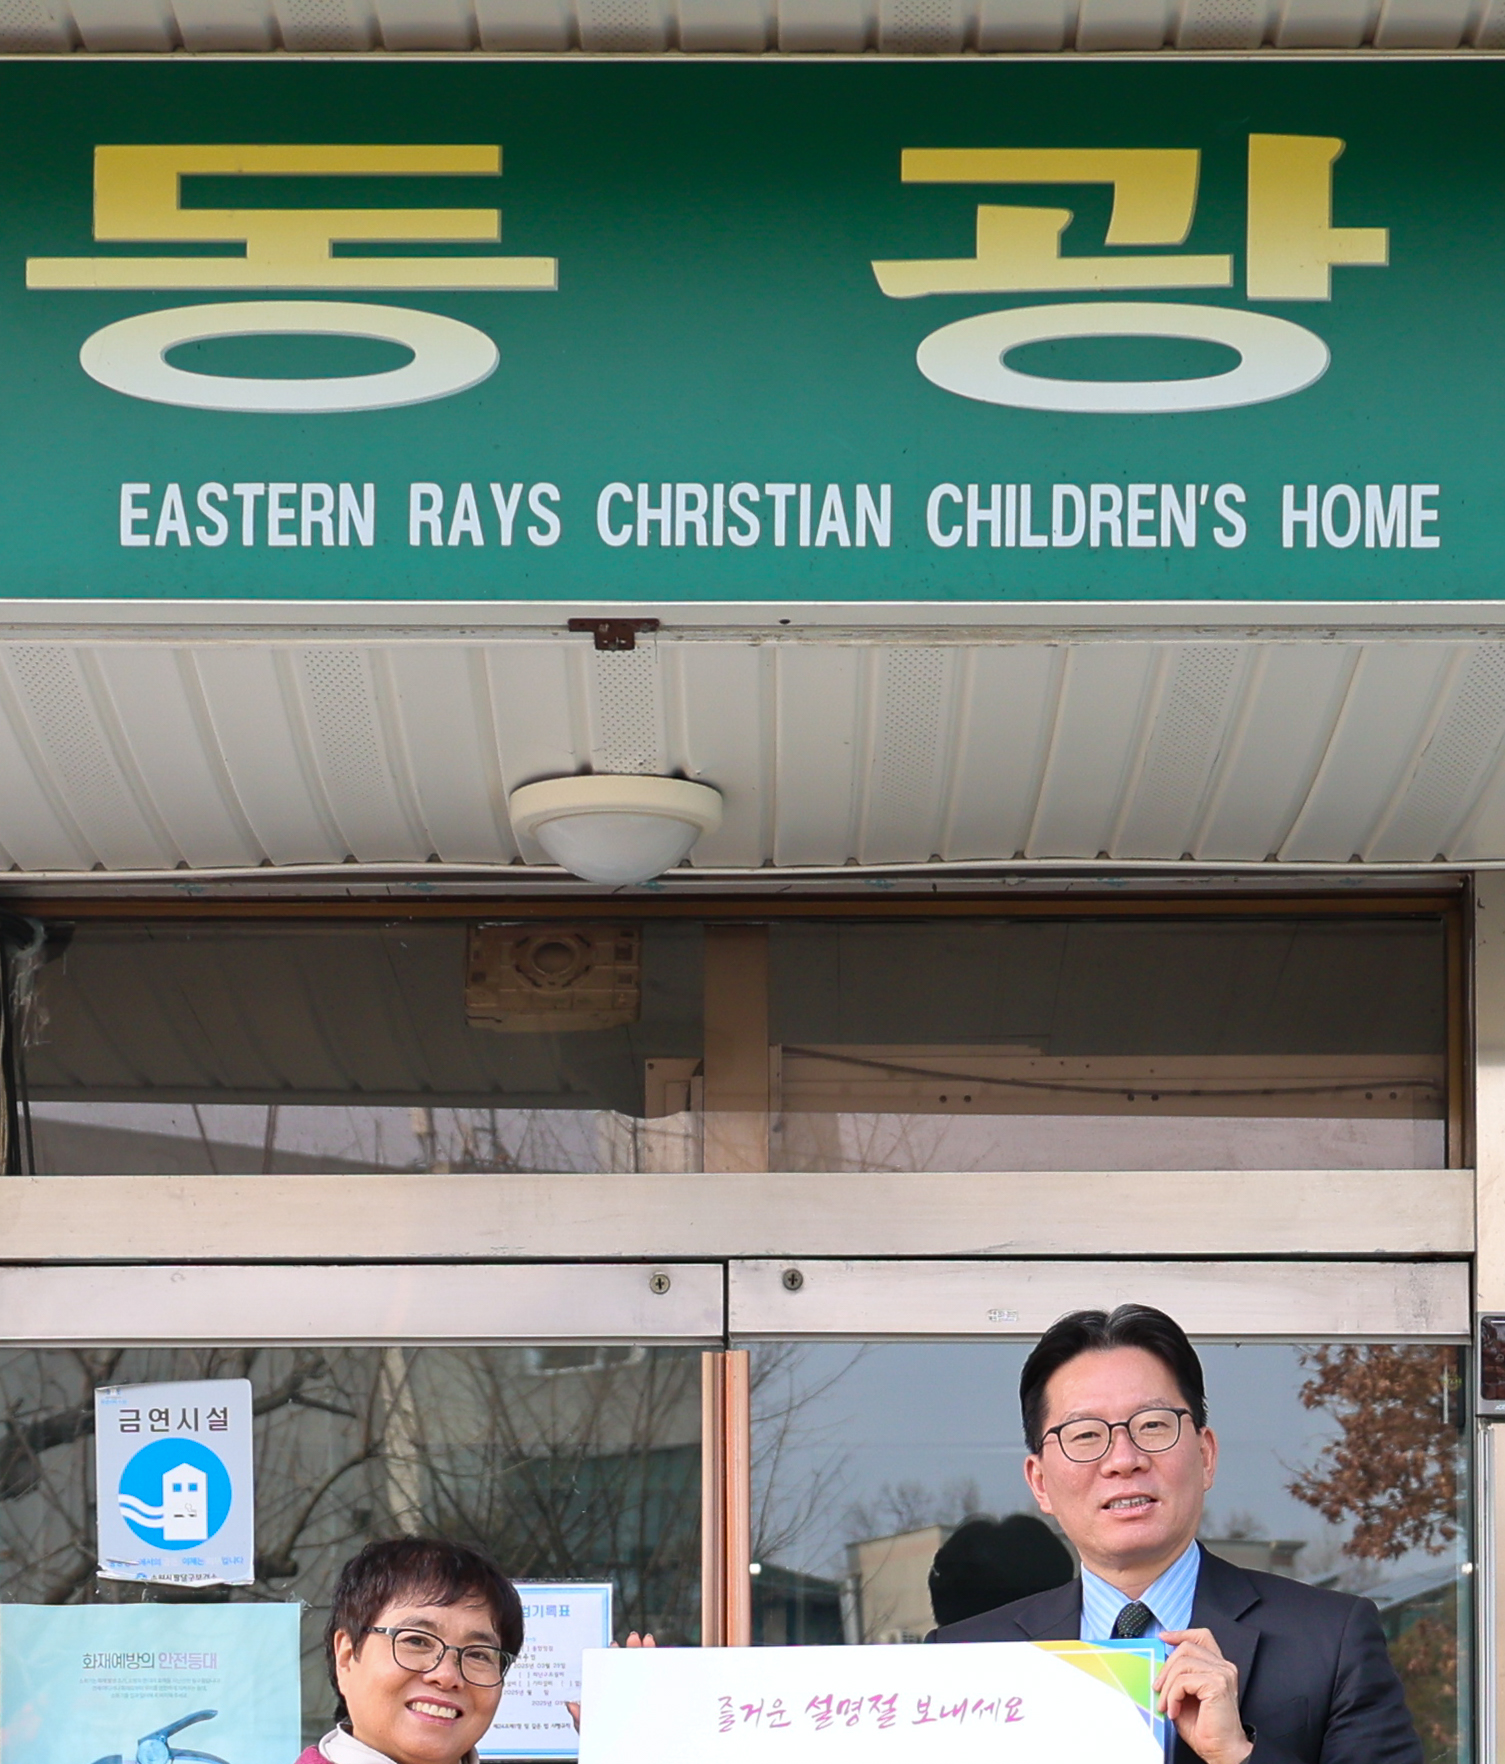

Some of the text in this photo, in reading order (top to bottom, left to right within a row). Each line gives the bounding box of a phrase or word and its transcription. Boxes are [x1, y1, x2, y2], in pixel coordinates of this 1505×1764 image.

[120, 482, 375, 547] EASTERN
[409, 482, 561, 547] RAYS
[597, 482, 891, 547] CHRISTIAN
[926, 483, 1247, 548] CHILDREN'S
[1282, 484, 1440, 548] HOME
[119, 1407, 228, 1433] 금연시설
[82, 1652, 217, 1670] 화재예방의 안전등대
[717, 1692, 1026, 1733] 즐거운 설명절 보내세요
